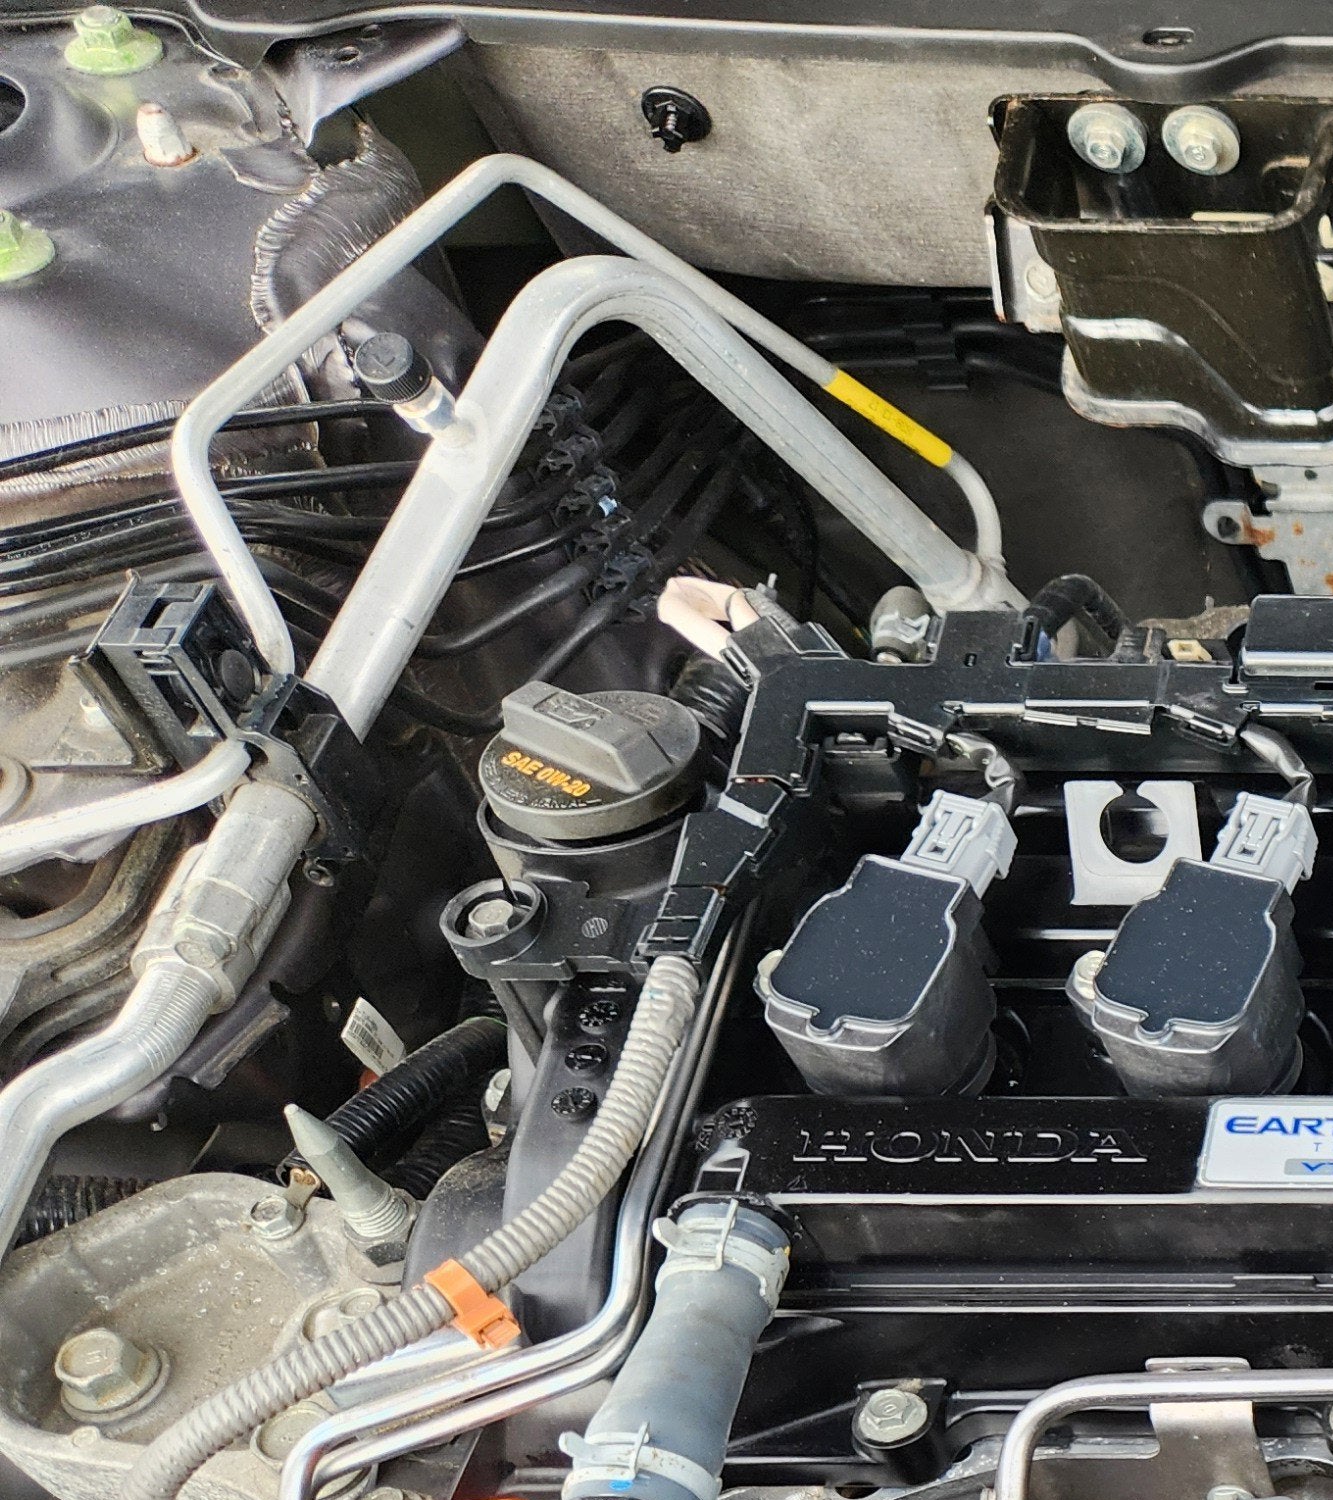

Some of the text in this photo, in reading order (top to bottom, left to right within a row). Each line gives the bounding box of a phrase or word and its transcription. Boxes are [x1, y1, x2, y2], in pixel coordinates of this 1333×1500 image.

[501, 751, 543, 776] SAE
[536, 767, 591, 797] 0W-20
[793, 1129, 1148, 1162] HONDA
